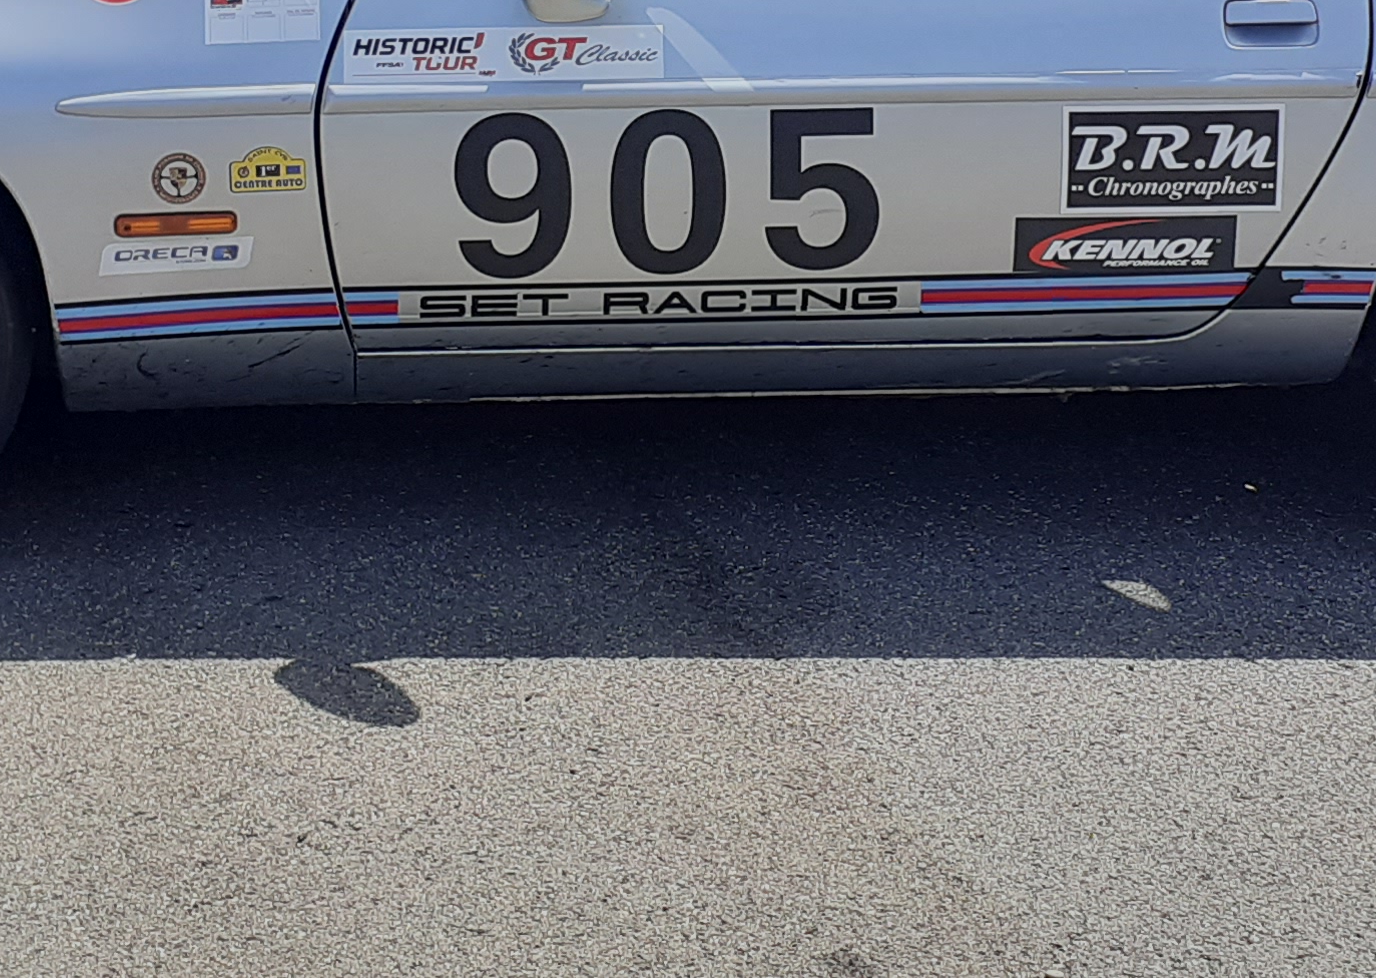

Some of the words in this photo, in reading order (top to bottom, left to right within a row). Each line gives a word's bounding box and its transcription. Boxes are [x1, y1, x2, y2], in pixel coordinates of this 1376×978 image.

[352, 35, 476, 56] HISTORIC
[524, 36, 588, 61] GT
[575, 44, 659, 66] Classic
[412, 56, 478, 71] TOUR
[234, 179, 273, 189] CENTRE
[275, 178, 303, 187] AUTO
[453, 107, 880, 278] 905
[1087, 175, 1258, 201] Chronographes
[114, 245, 209, 262] ORECA
[1041, 237, 1214, 261] KENNOL
[1102, 259, 1189, 268] PERFORMANCE
[1191, 258, 1210, 266] OIL
[419, 293, 569, 319] SET
[603, 286, 898, 316] RACING
